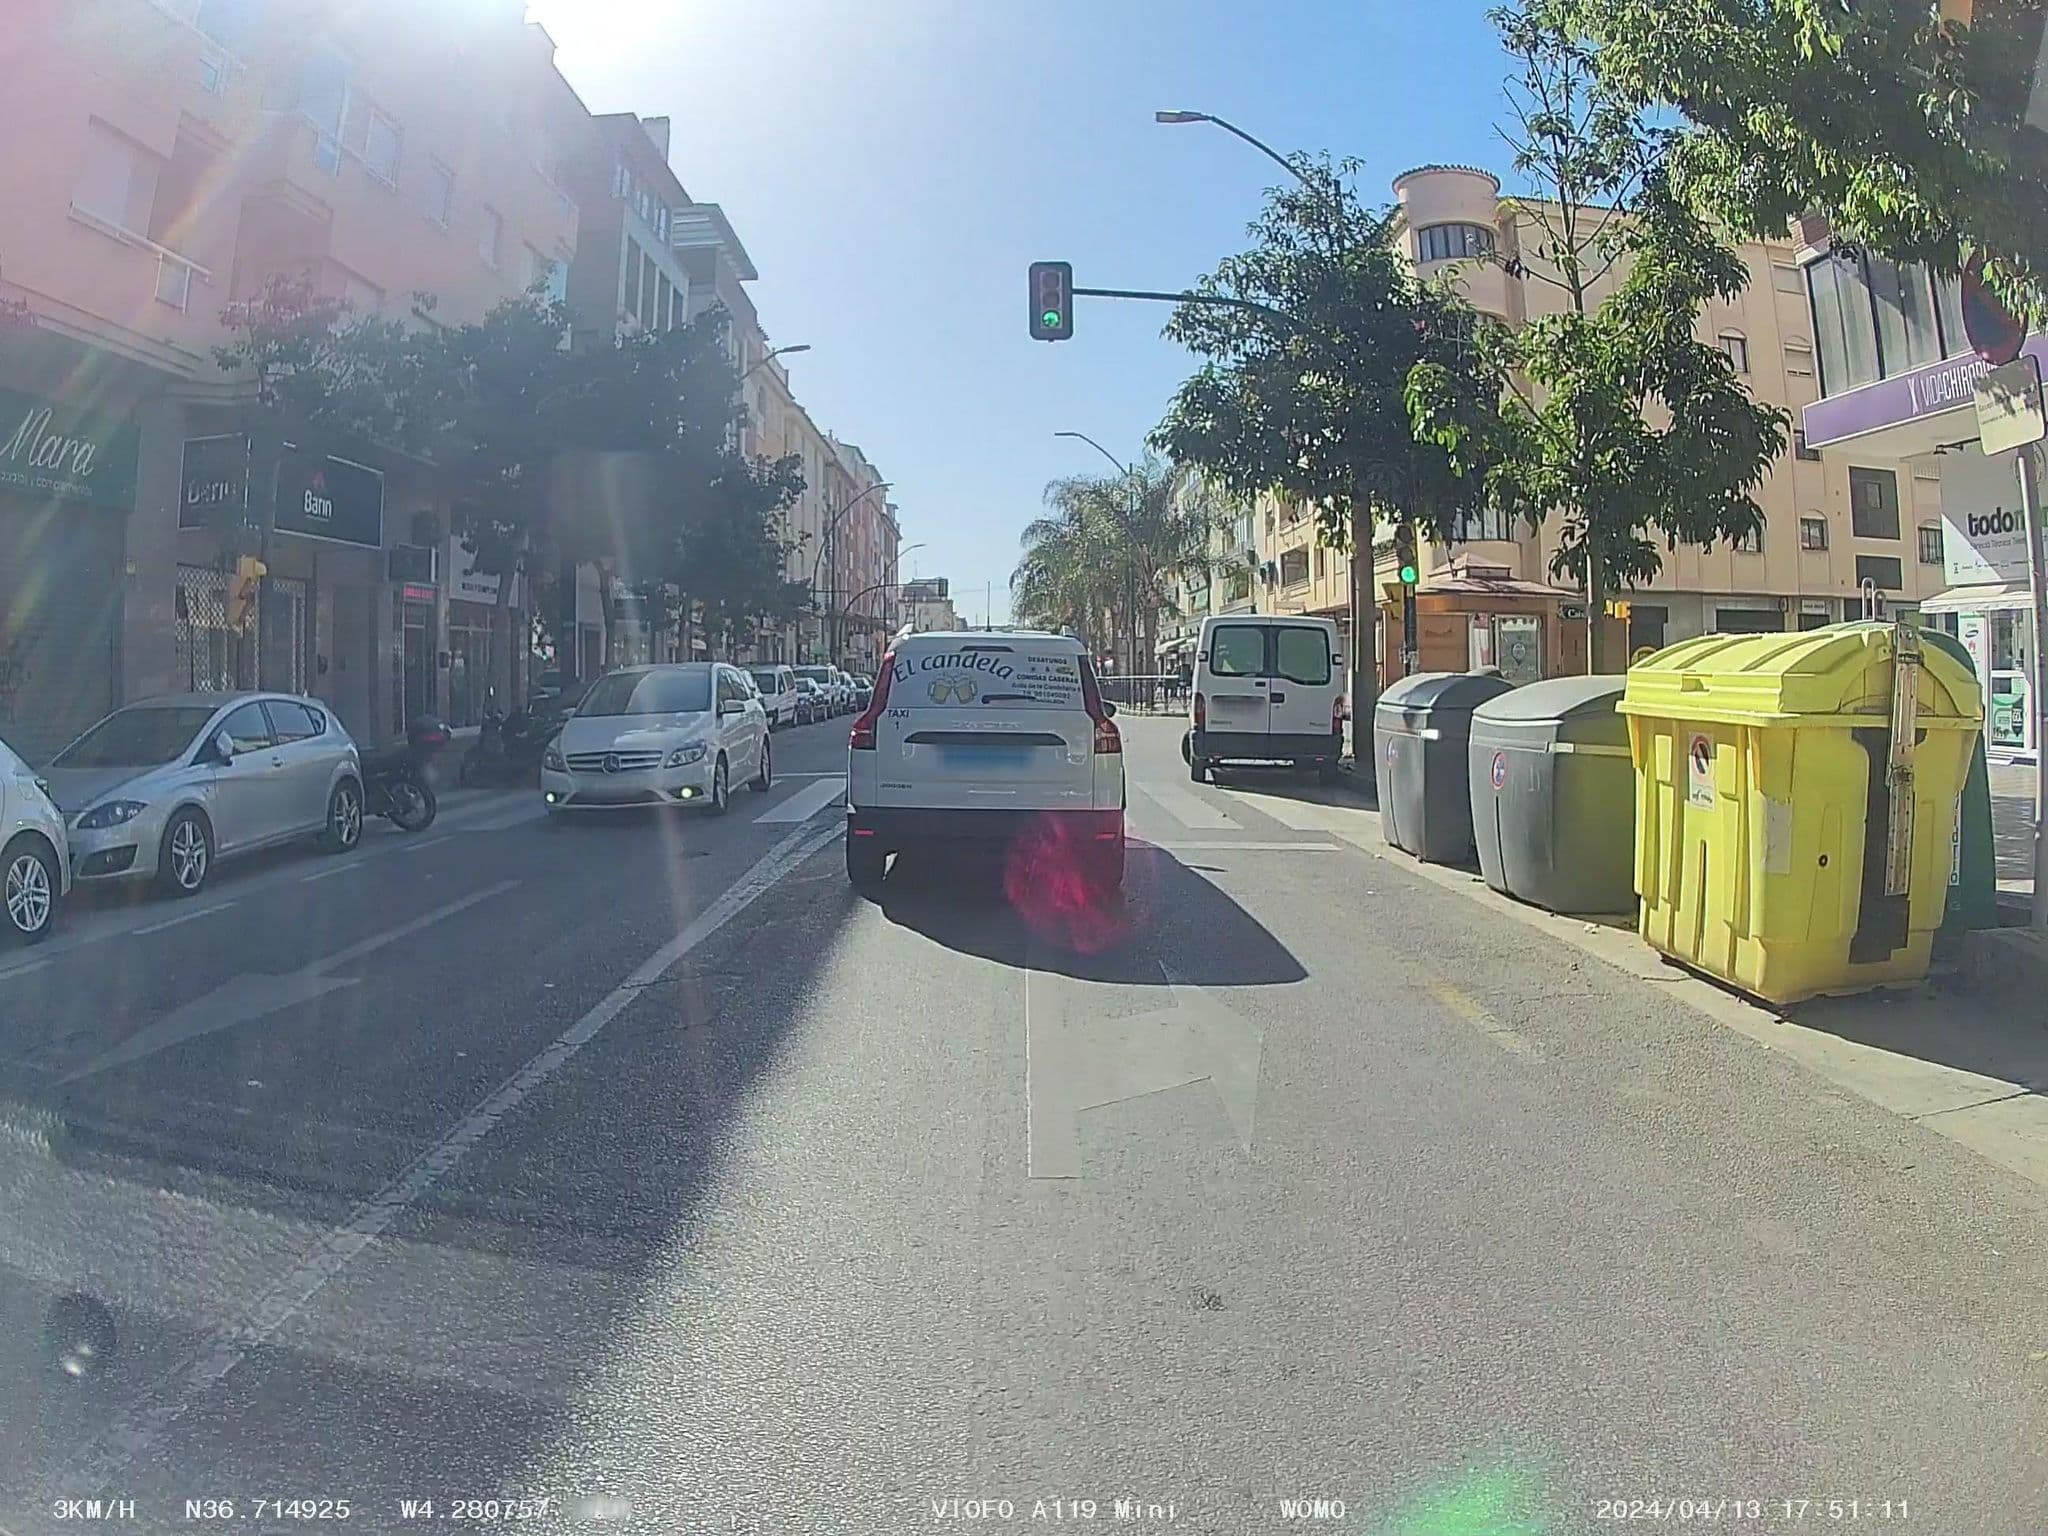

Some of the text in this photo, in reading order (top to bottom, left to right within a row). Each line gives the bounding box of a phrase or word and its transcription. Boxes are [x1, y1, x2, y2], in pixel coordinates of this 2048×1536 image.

[893, 652, 1014, 683] El candela
[887, 709, 909, 718] TAXI
[895, 721, 900, 730] 1
